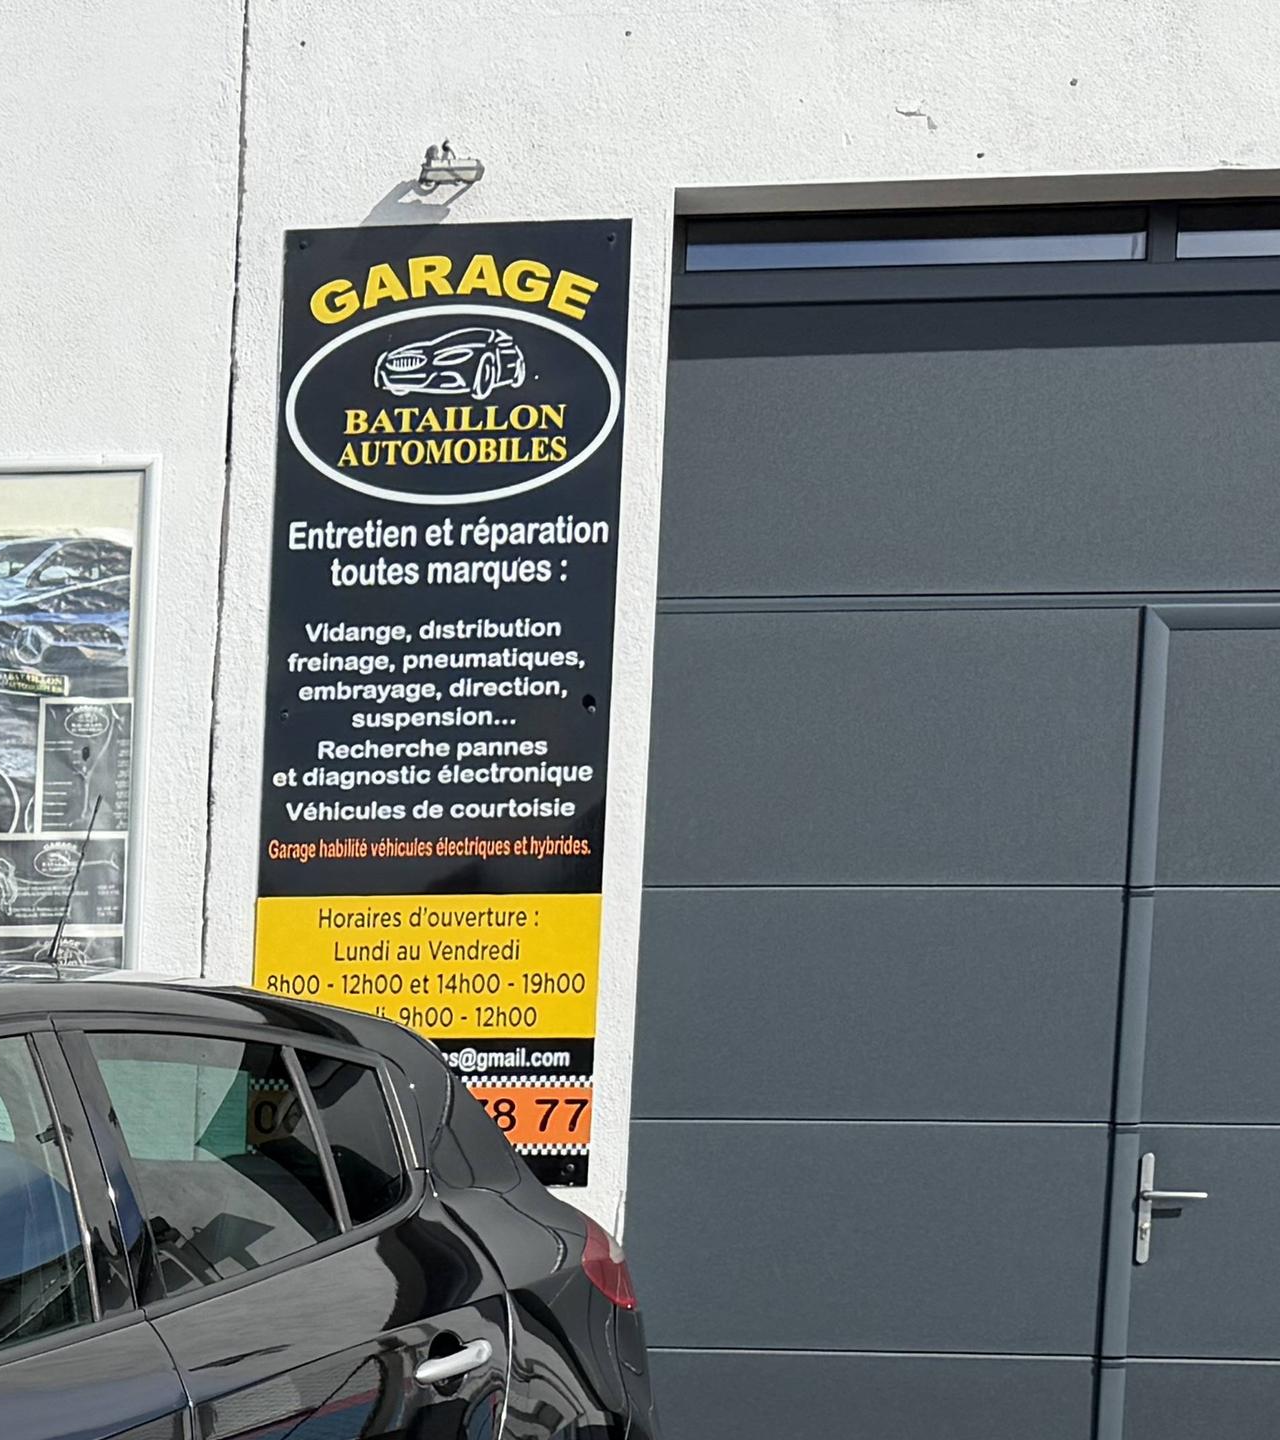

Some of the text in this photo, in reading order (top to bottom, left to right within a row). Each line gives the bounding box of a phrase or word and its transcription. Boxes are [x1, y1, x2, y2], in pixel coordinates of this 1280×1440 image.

[310, 254, 599, 324] GARAGE
[343, 404, 566, 435] BATAILLON
[337, 436, 568, 467] AUTOMOBILES
[288, 515, 609, 551] Entretien et réparation
[331, 557, 420, 586] toutes
[427, 557, 552, 589] marques
[305, 618, 562, 645] Vidange, distribution
[287, 648, 586, 675] freinage, pneumatiques,
[298, 677, 568, 703] embrayage, direction,
[352, 707, 516, 731] suspension...
[317, 739, 548, 761] Recherche pannes
[272, 762, 593, 789] et diagnostic électronique
[286, 798, 576, 821] Véhicules de courtoisie
[268, 835, 591, 862] Garage habilité véhicules électriques et hybrides.
[318, 908, 401, 928] Horaires
[334, 939, 520, 961] Lundi au Vendredi
[267, 974, 319, 994] 8h00
[341, 974, 403, 994] 12h00
[410, 975, 429, 994] et
[436, 973, 500, 994] 14h00
[522, 972, 586, 994] 19h00
[399, 1007, 453, 1028] 9h00
[475, 1007, 537, 1028] 12h00
[535, 1099, 589, 1132] 77
